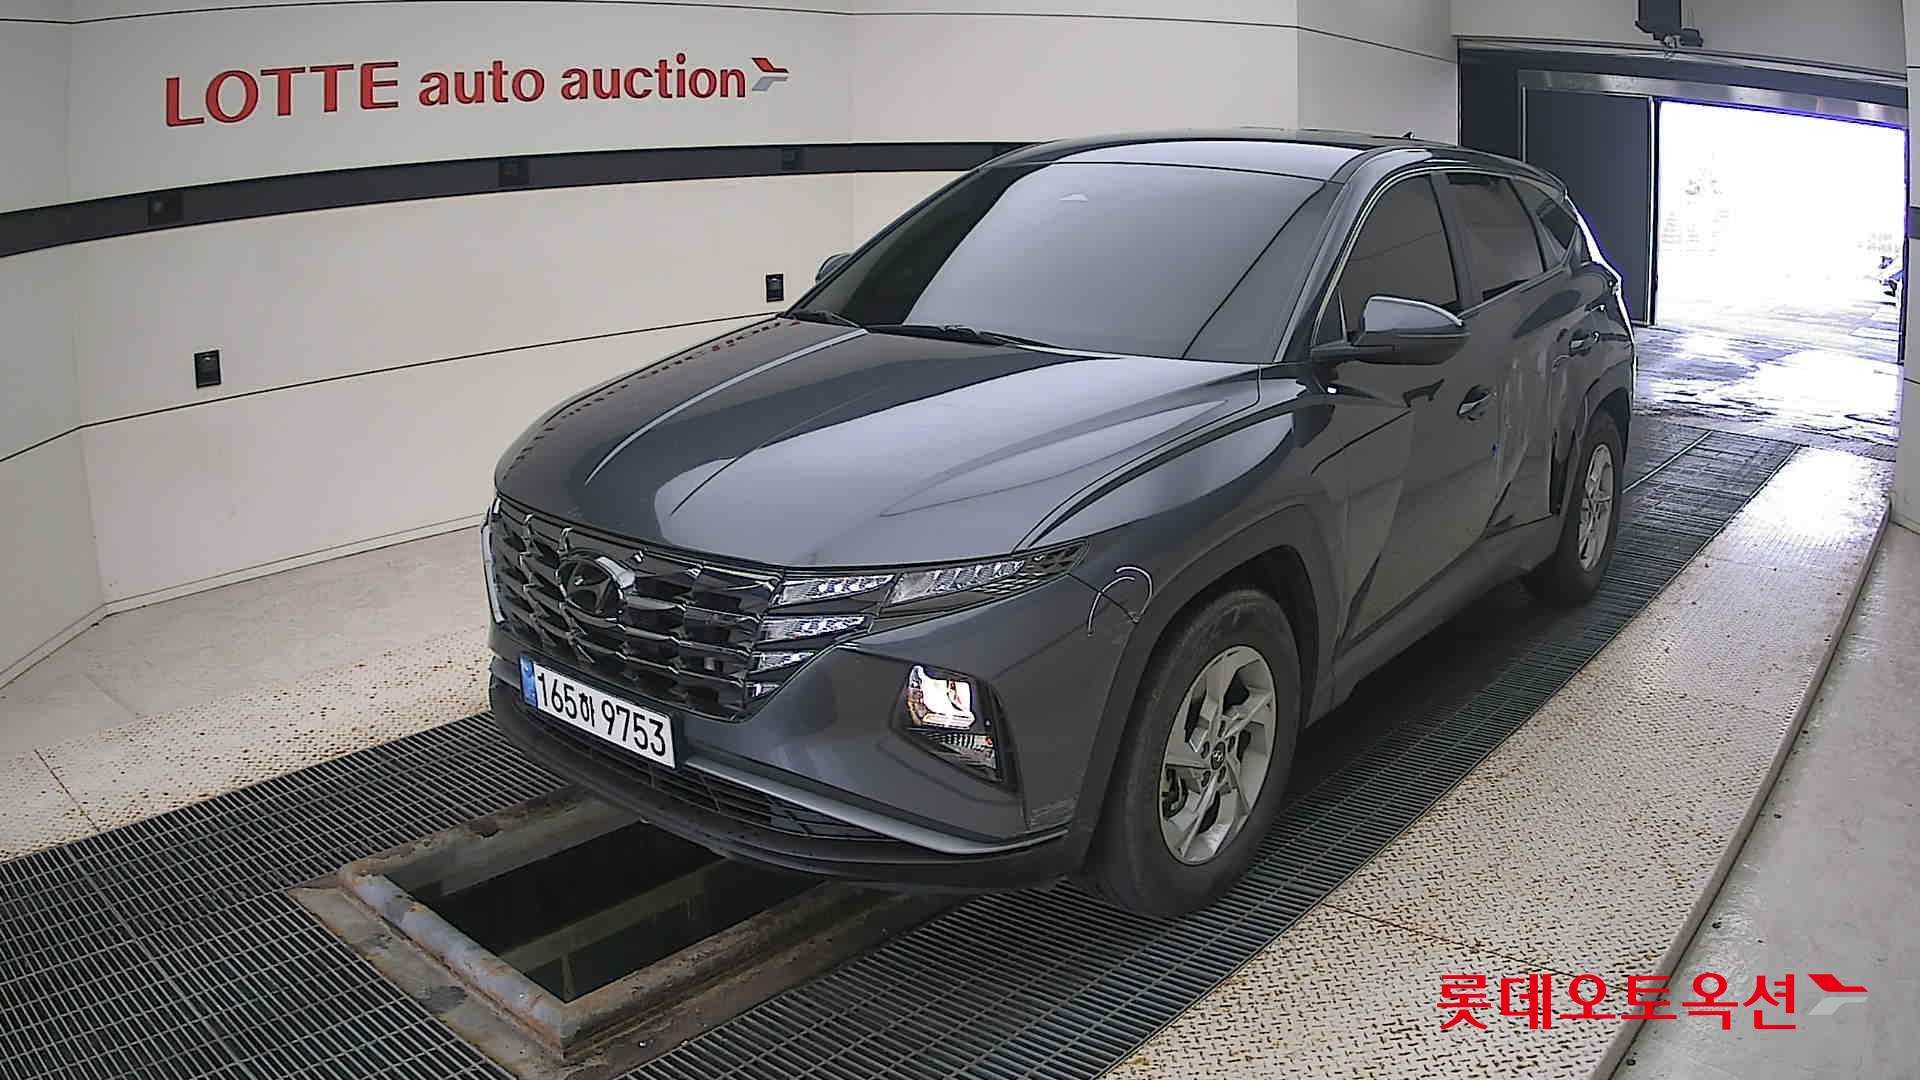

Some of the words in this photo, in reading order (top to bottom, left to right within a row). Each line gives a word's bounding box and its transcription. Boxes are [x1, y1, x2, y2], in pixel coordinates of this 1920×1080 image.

[165, 61, 399, 127] LOTTE
[418, 60, 545, 105] auto
[560, 53, 746, 100] auction
[537, 673, 596, 728] 165하
[601, 700, 666, 757] 9753
